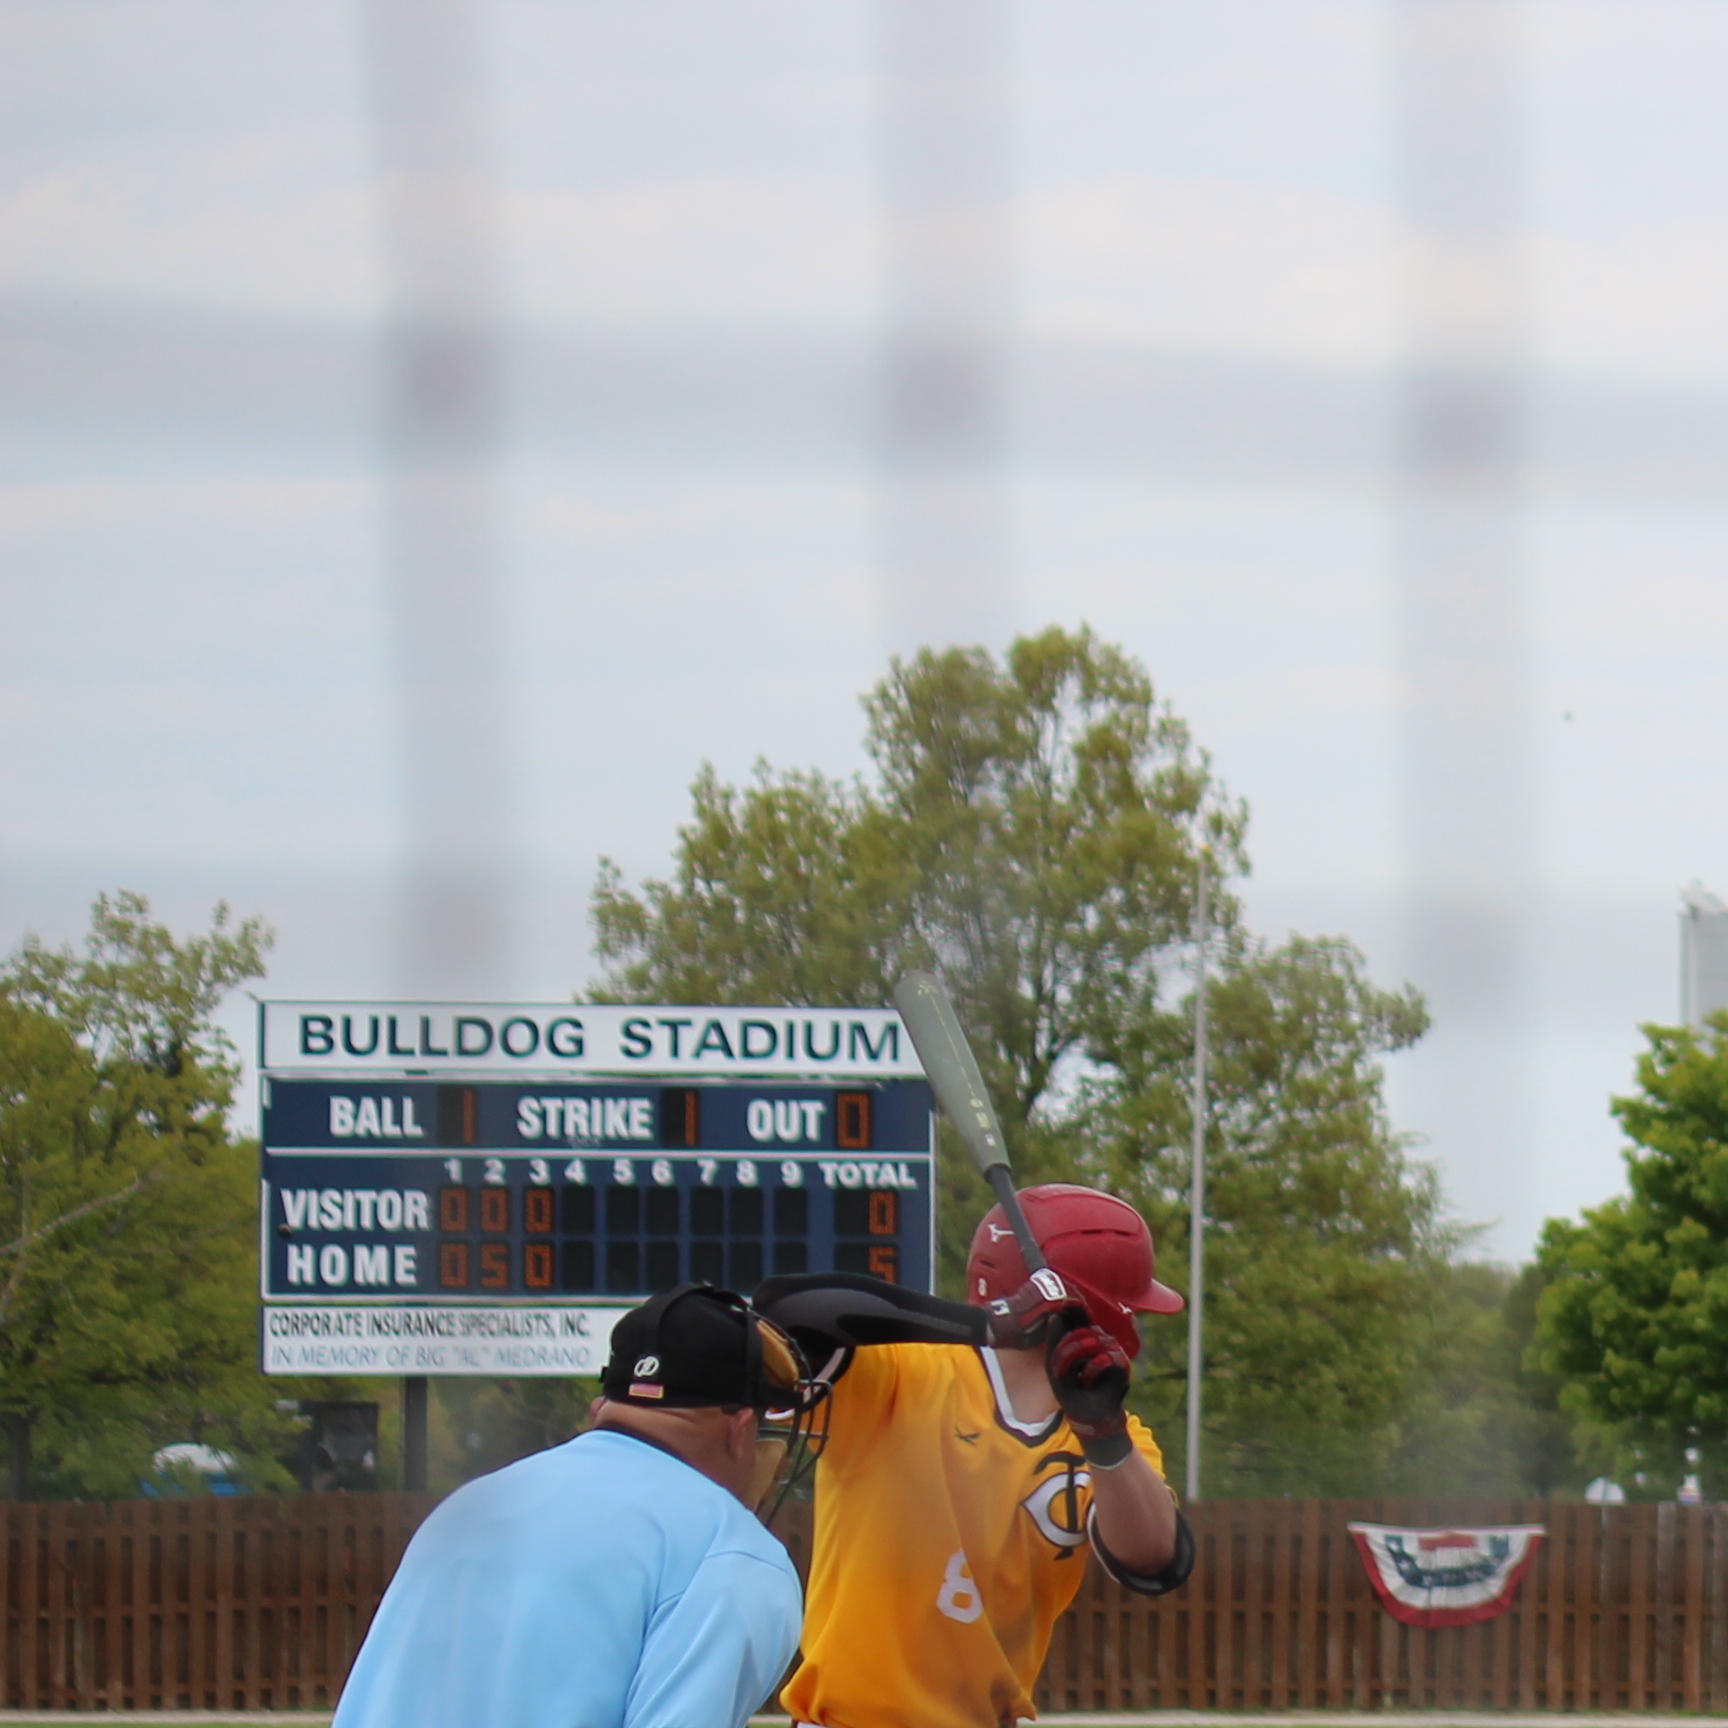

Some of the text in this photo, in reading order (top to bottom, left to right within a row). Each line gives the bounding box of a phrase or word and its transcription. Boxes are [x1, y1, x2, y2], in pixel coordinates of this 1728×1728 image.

[300, 1014, 899, 1062] BULLDOG STADIUM
[329, 1095, 425, 1138] BALL
[516, 1096, 654, 1140] STRIKE
[747, 1099, 826, 1142] OUT
[444, 1158, 918, 1189] 1 2 3 4 5 6 7 8 9 TOTAL
[280, 1189, 431, 1231] VISITOR
[287, 1243, 418, 1286] HOME
[269, 1312, 362, 1338] CORPORATE
[367, 1312, 455, 1338] INSURANCE
[271, 1346, 290, 1366] IN
[297, 1346, 379, 1366] MEMORY
[385, 1346, 410, 1366] OF
[415, 1346, 445, 1367] BIG
